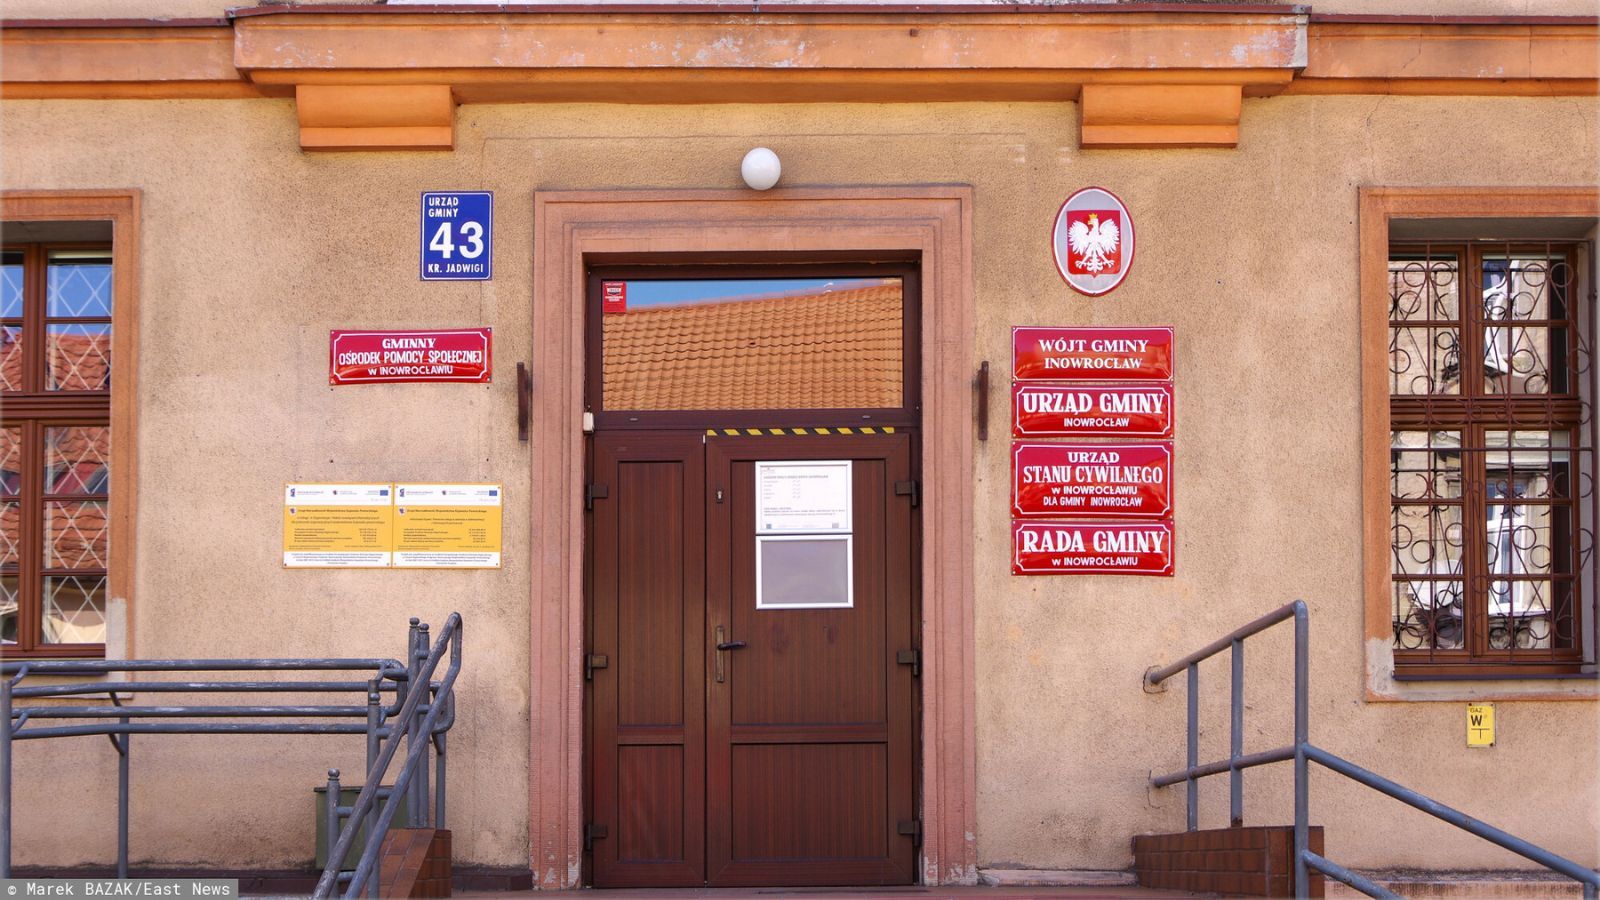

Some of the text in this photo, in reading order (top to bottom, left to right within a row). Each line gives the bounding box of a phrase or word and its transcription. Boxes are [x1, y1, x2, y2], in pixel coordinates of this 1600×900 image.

[428, 197, 459, 207] URZĄD
[428, 208, 459, 218] GMINY
[429, 221, 484, 259] 43
[428, 263, 483, 273] KR. JADWIGI
[382, 338, 436, 349] GMINNY
[1038, 337, 1149, 353] WÓJT GMINY
[339, 350, 482, 365] OŚRODEK POMOCY SPOŁECZNEJ
[1044, 357, 1142, 369] INOWROCŁAW
[380, 365, 453, 375] INOWROCŁAWIU
[1022, 392, 1164, 415] URZĄD GMINY
[1064, 417, 1130, 427] INOWROCŁAW
[1067, 452, 1120, 465] URZĄD
[1023, 466, 1163, 483] STANU CYWILNEGO
[1063, 485, 1138, 495] INOWROCŁAWIU
[1043, 497, 1142, 507] DLA GMINY INOWROCŁAW
[1021, 530, 1165, 553] RADA GMINY
[1063, 557, 1138, 566] INOWROCŁAWIU
[1470, 714, 1482, 726] W
